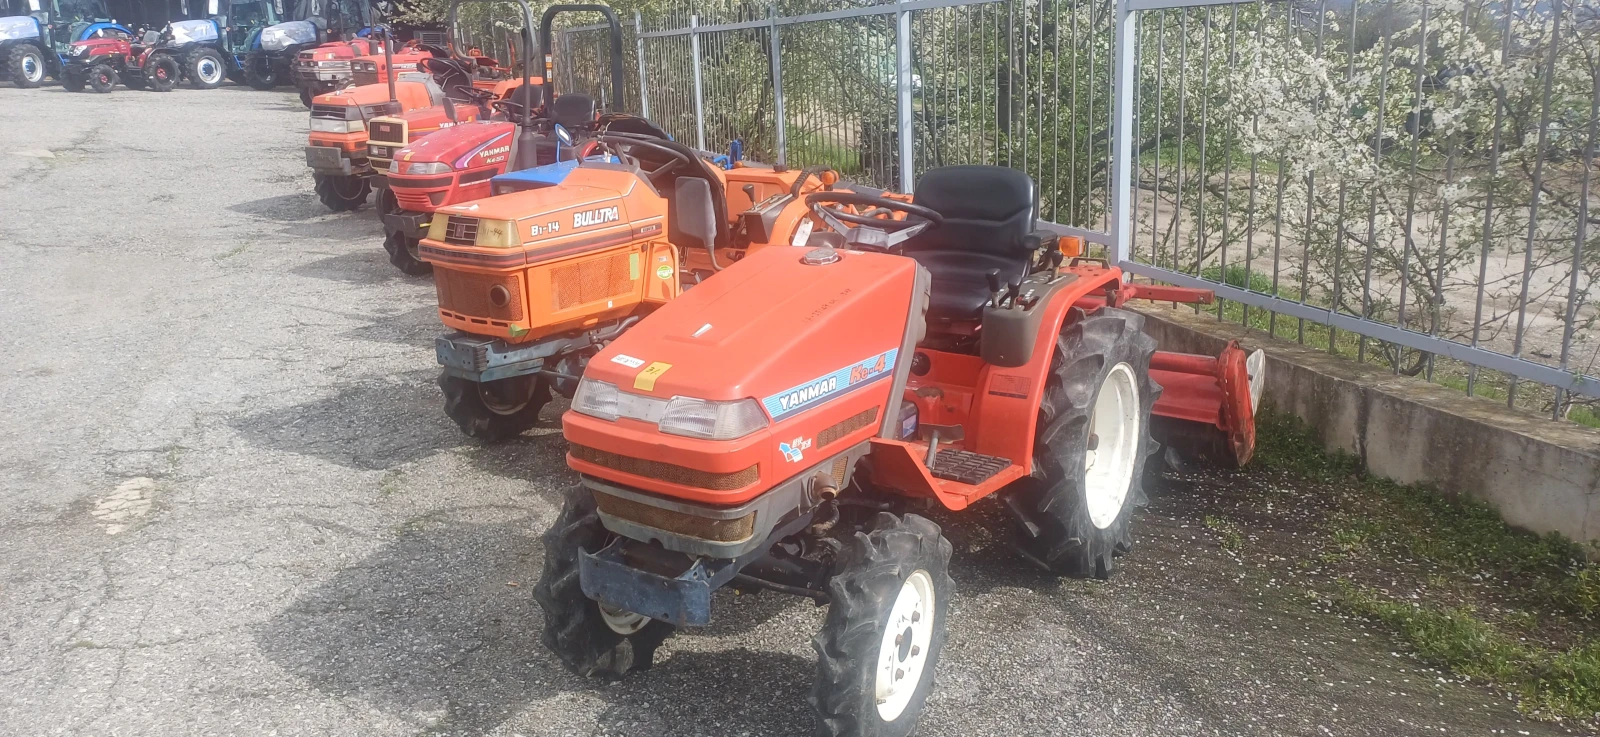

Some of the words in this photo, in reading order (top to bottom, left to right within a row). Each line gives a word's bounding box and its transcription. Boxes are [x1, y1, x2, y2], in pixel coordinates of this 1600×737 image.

[479, 145, 510, 158] YANMAR
[573, 206, 619, 228] BULLTRA
[779, 375, 838, 411] YANMAR
[849, 354, 886, 385] Ke-4
